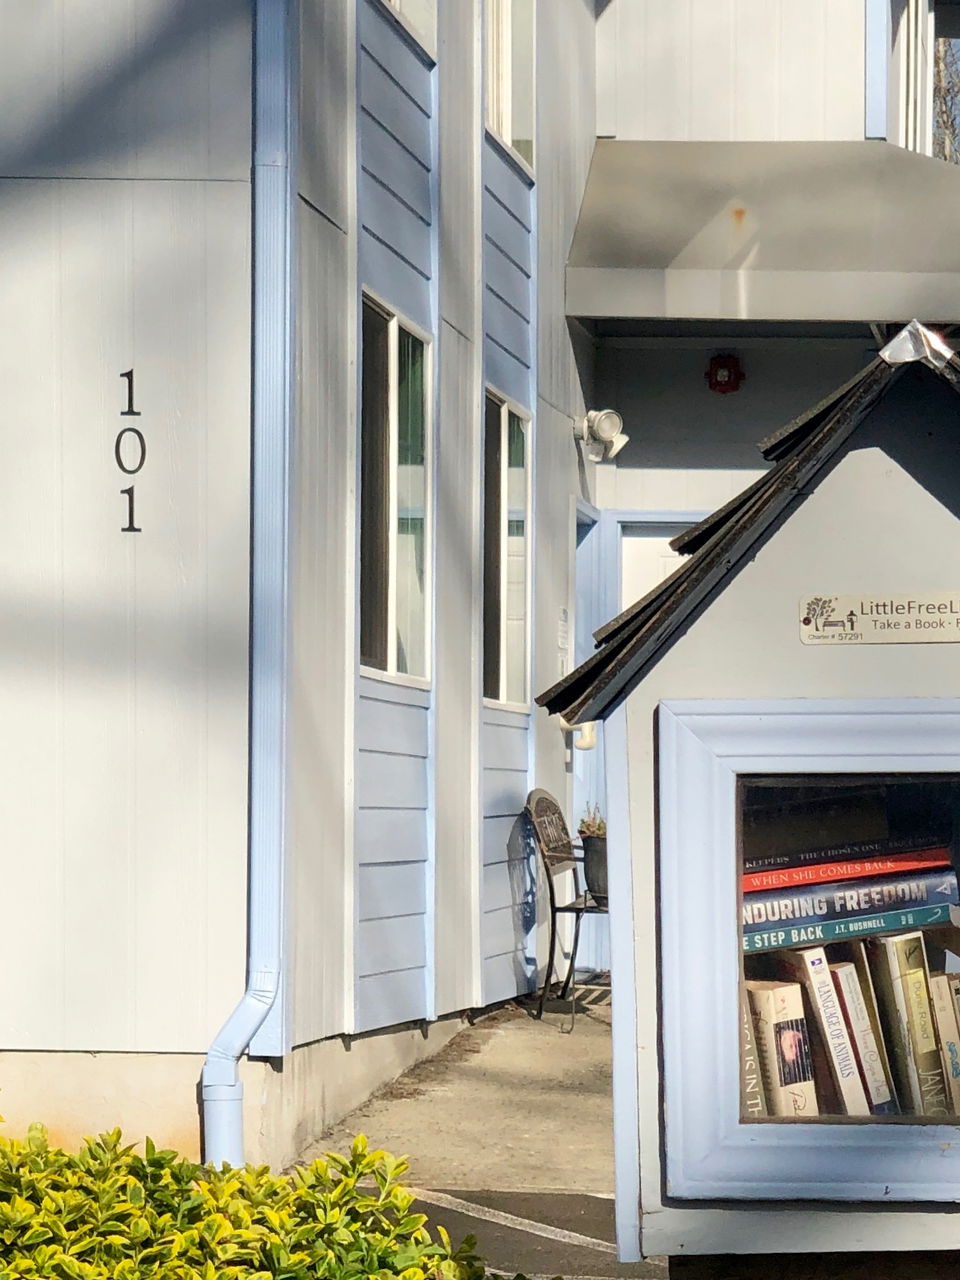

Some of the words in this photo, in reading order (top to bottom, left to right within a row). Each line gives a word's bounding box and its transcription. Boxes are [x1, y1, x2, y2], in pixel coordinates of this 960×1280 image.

[115, 369, 146, 532] 101
[872, 618, 901, 630] Take
[904, 621, 911, 629] a
[915, 618, 946, 629] Book
[837, 632, 863, 641] 57291
[745, 856, 789, 868] KEEPERS
[799, 851, 819, 861] THE
[861, 842, 882, 852] ONE
[751, 872, 789, 887] WHEN
[793, 869, 816, 882] SHE
[819, 864, 861, 879] COMES
[864, 860, 895, 871] BACK
[834, 882, 928, 912] FREEDOM
[754, 932, 785, 948] STEP
[791, 926, 824, 943] BACK
[835, 924, 848, 934] J.T.
[849, 918, 886, 932] BUSHNELL
[818, 983, 841, 1027] LANGUAGE
[829, 1028, 844, 1040] OF
[834, 1042, 855, 1079] ANIMALS
[746, 1074, 759, 1092] IN
